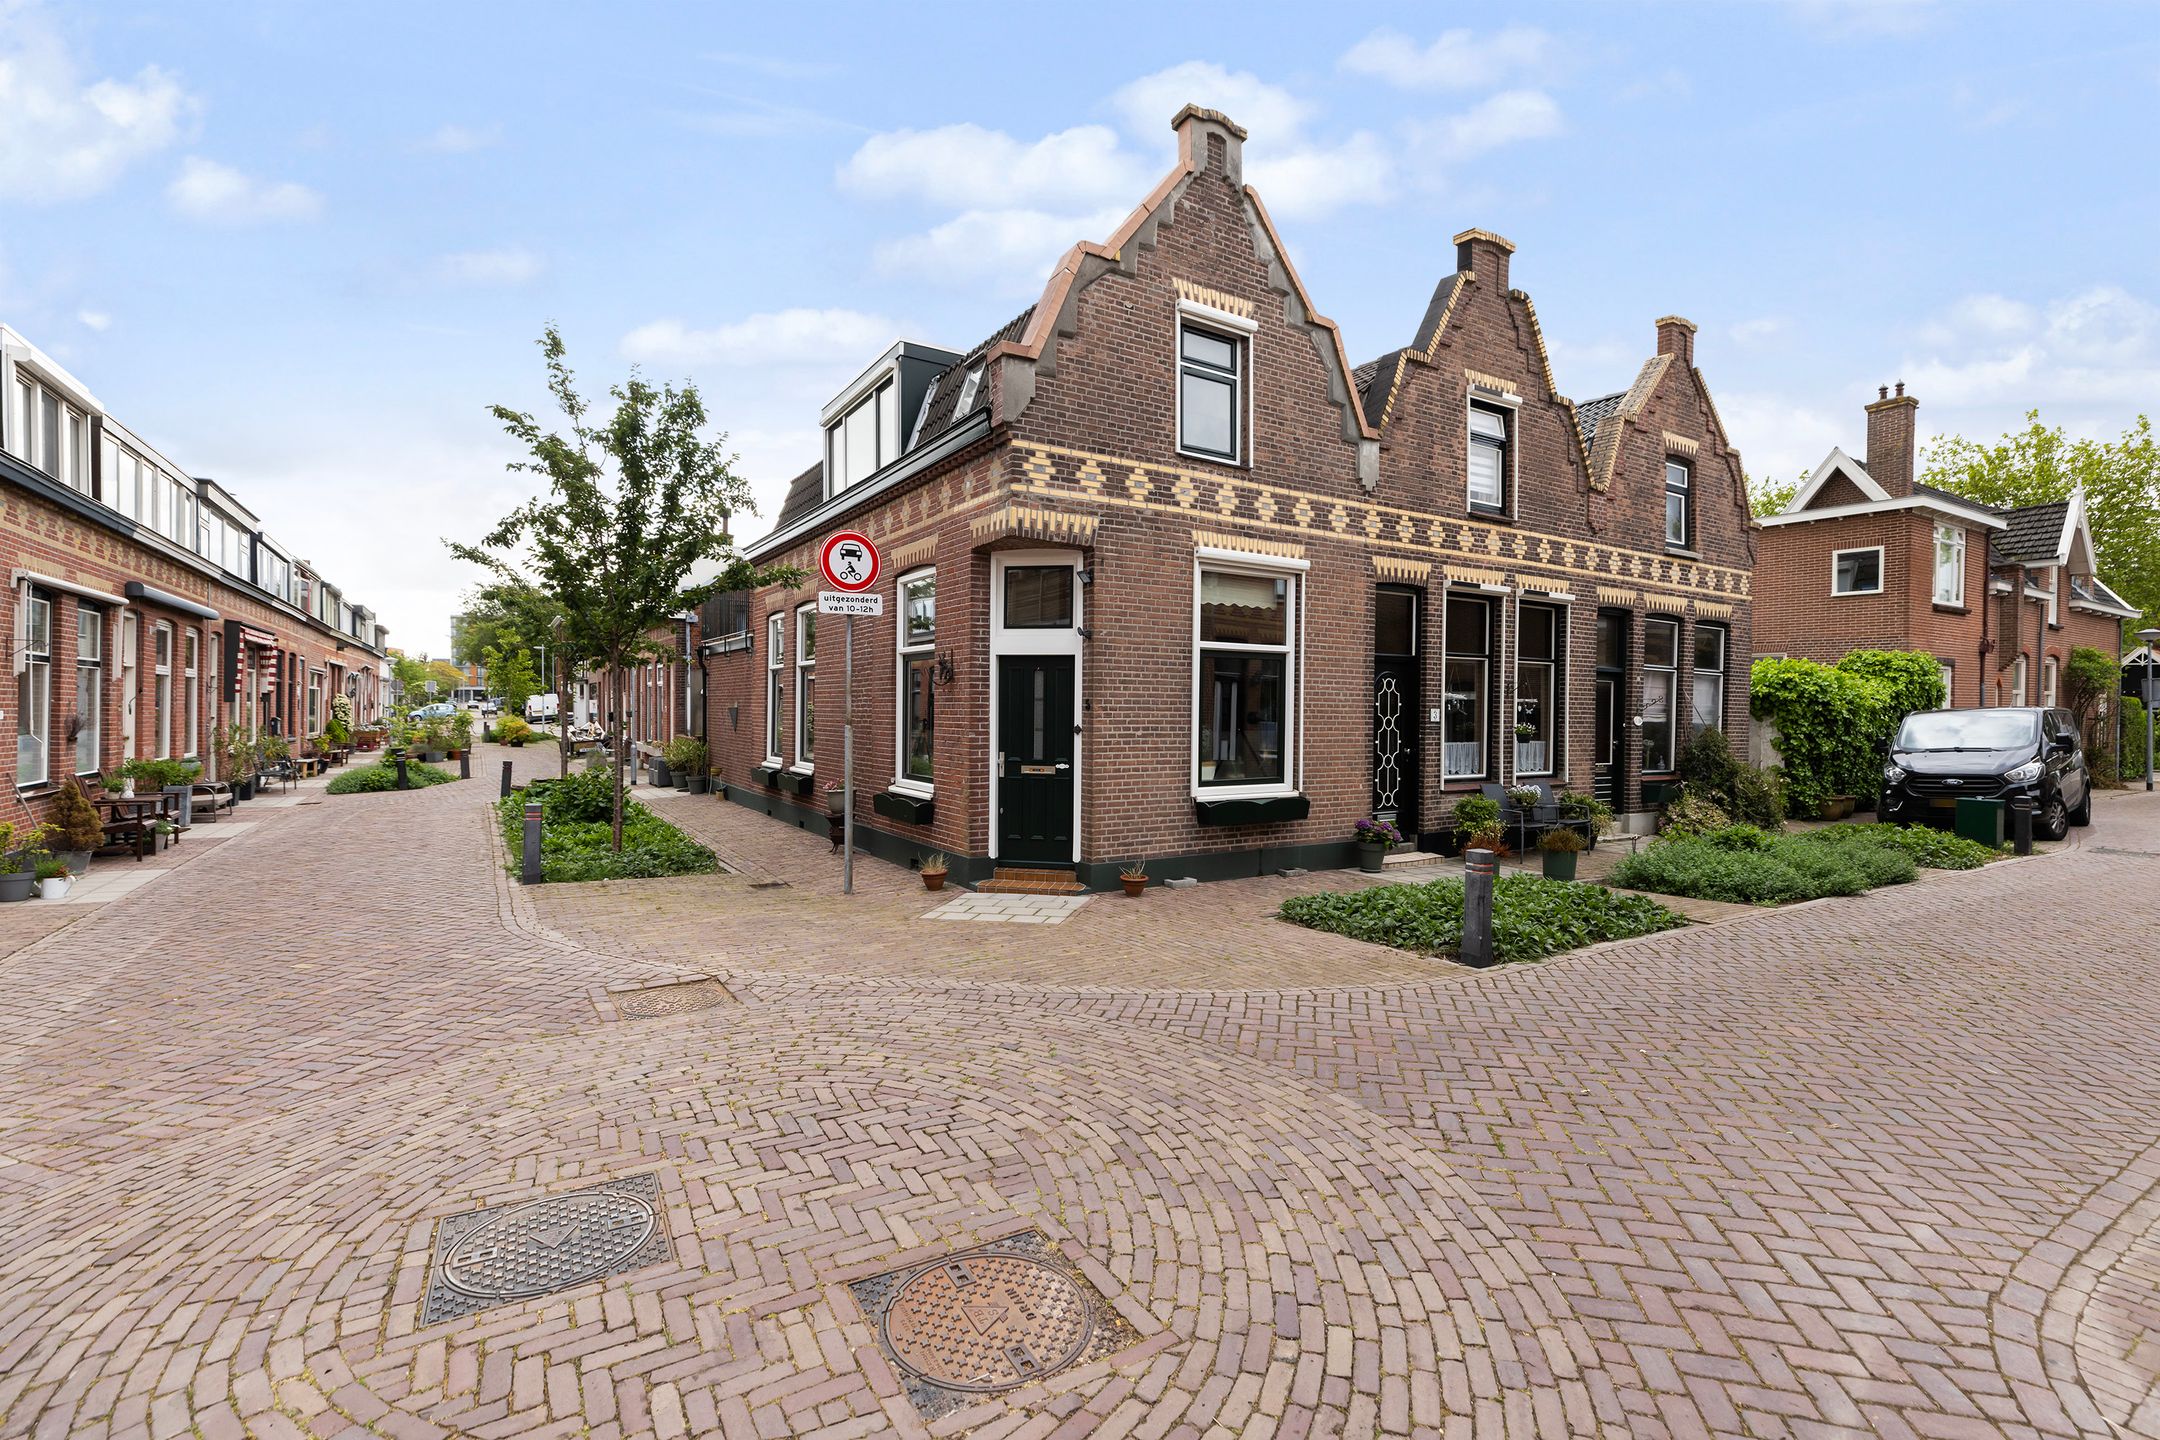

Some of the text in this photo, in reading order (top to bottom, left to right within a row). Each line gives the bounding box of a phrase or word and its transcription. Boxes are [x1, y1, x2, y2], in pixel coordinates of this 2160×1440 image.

[824, 595, 878, 604] uitgezonderd
[846, 605, 874, 613] 10-12h
[1005, 1287, 1037, 1321] DRAIN
